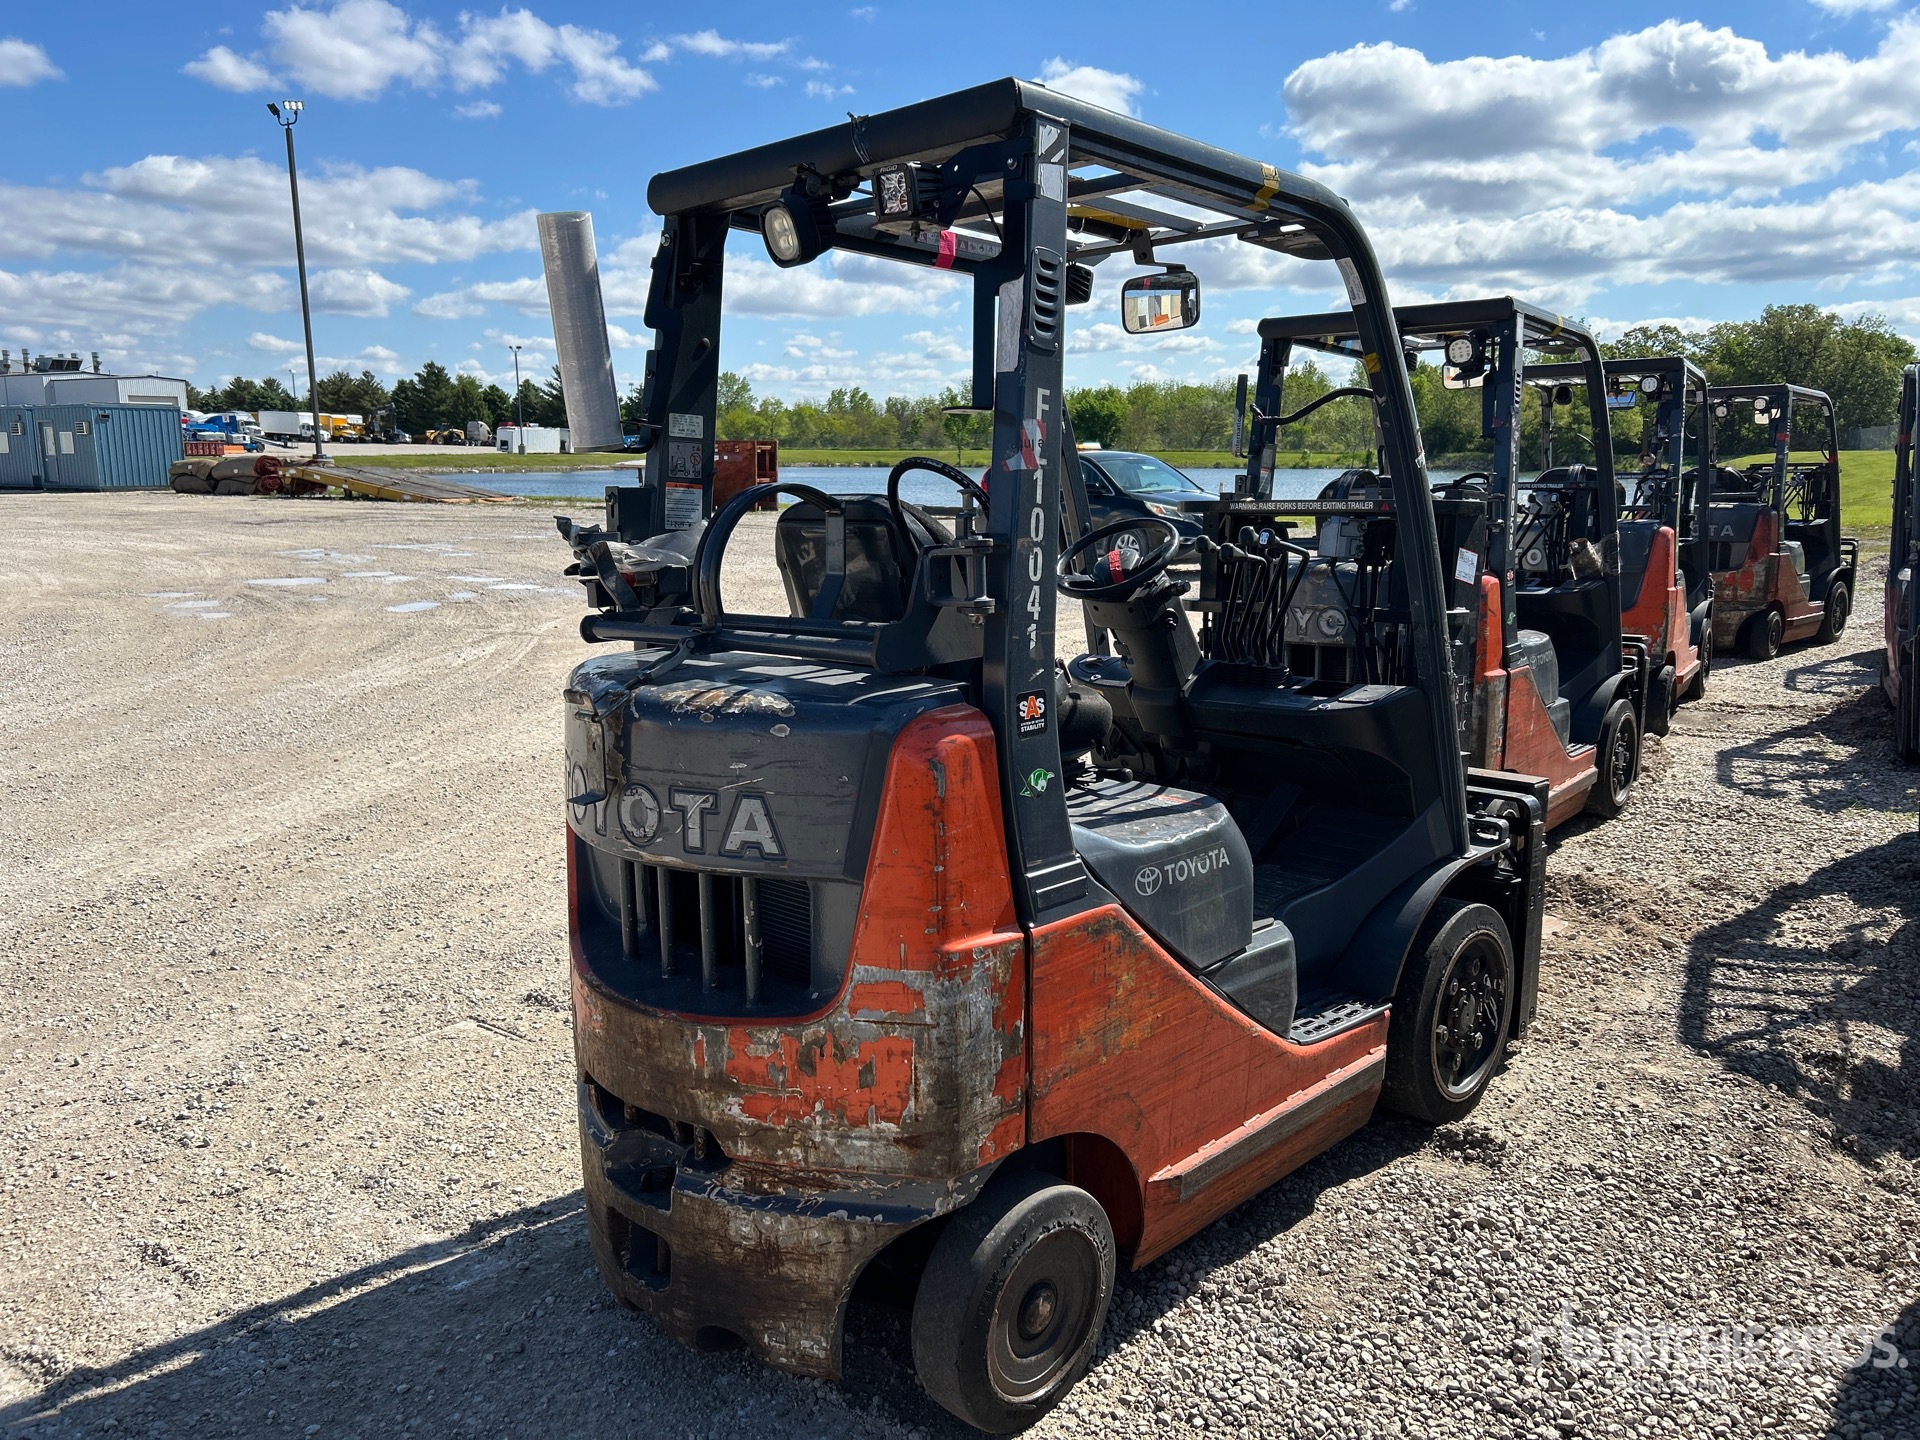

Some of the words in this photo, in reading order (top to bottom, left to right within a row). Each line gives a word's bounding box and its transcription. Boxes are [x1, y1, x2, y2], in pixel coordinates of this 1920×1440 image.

[1229, 502, 1258, 510] WARNING:
[1258, 502, 1276, 510] RAISE
[1276, 502, 1297, 510] FORKS
[1297, 502, 1322, 510] BEFORE
[1322, 502, 1346, 510] EXITING
[1347, 502, 1374, 510] TRAILER
[1019, 695, 1045, 719] SAS
[1021, 722, 1045, 732] STABILITY
[1164, 847, 1230, 885] TOYOTA
